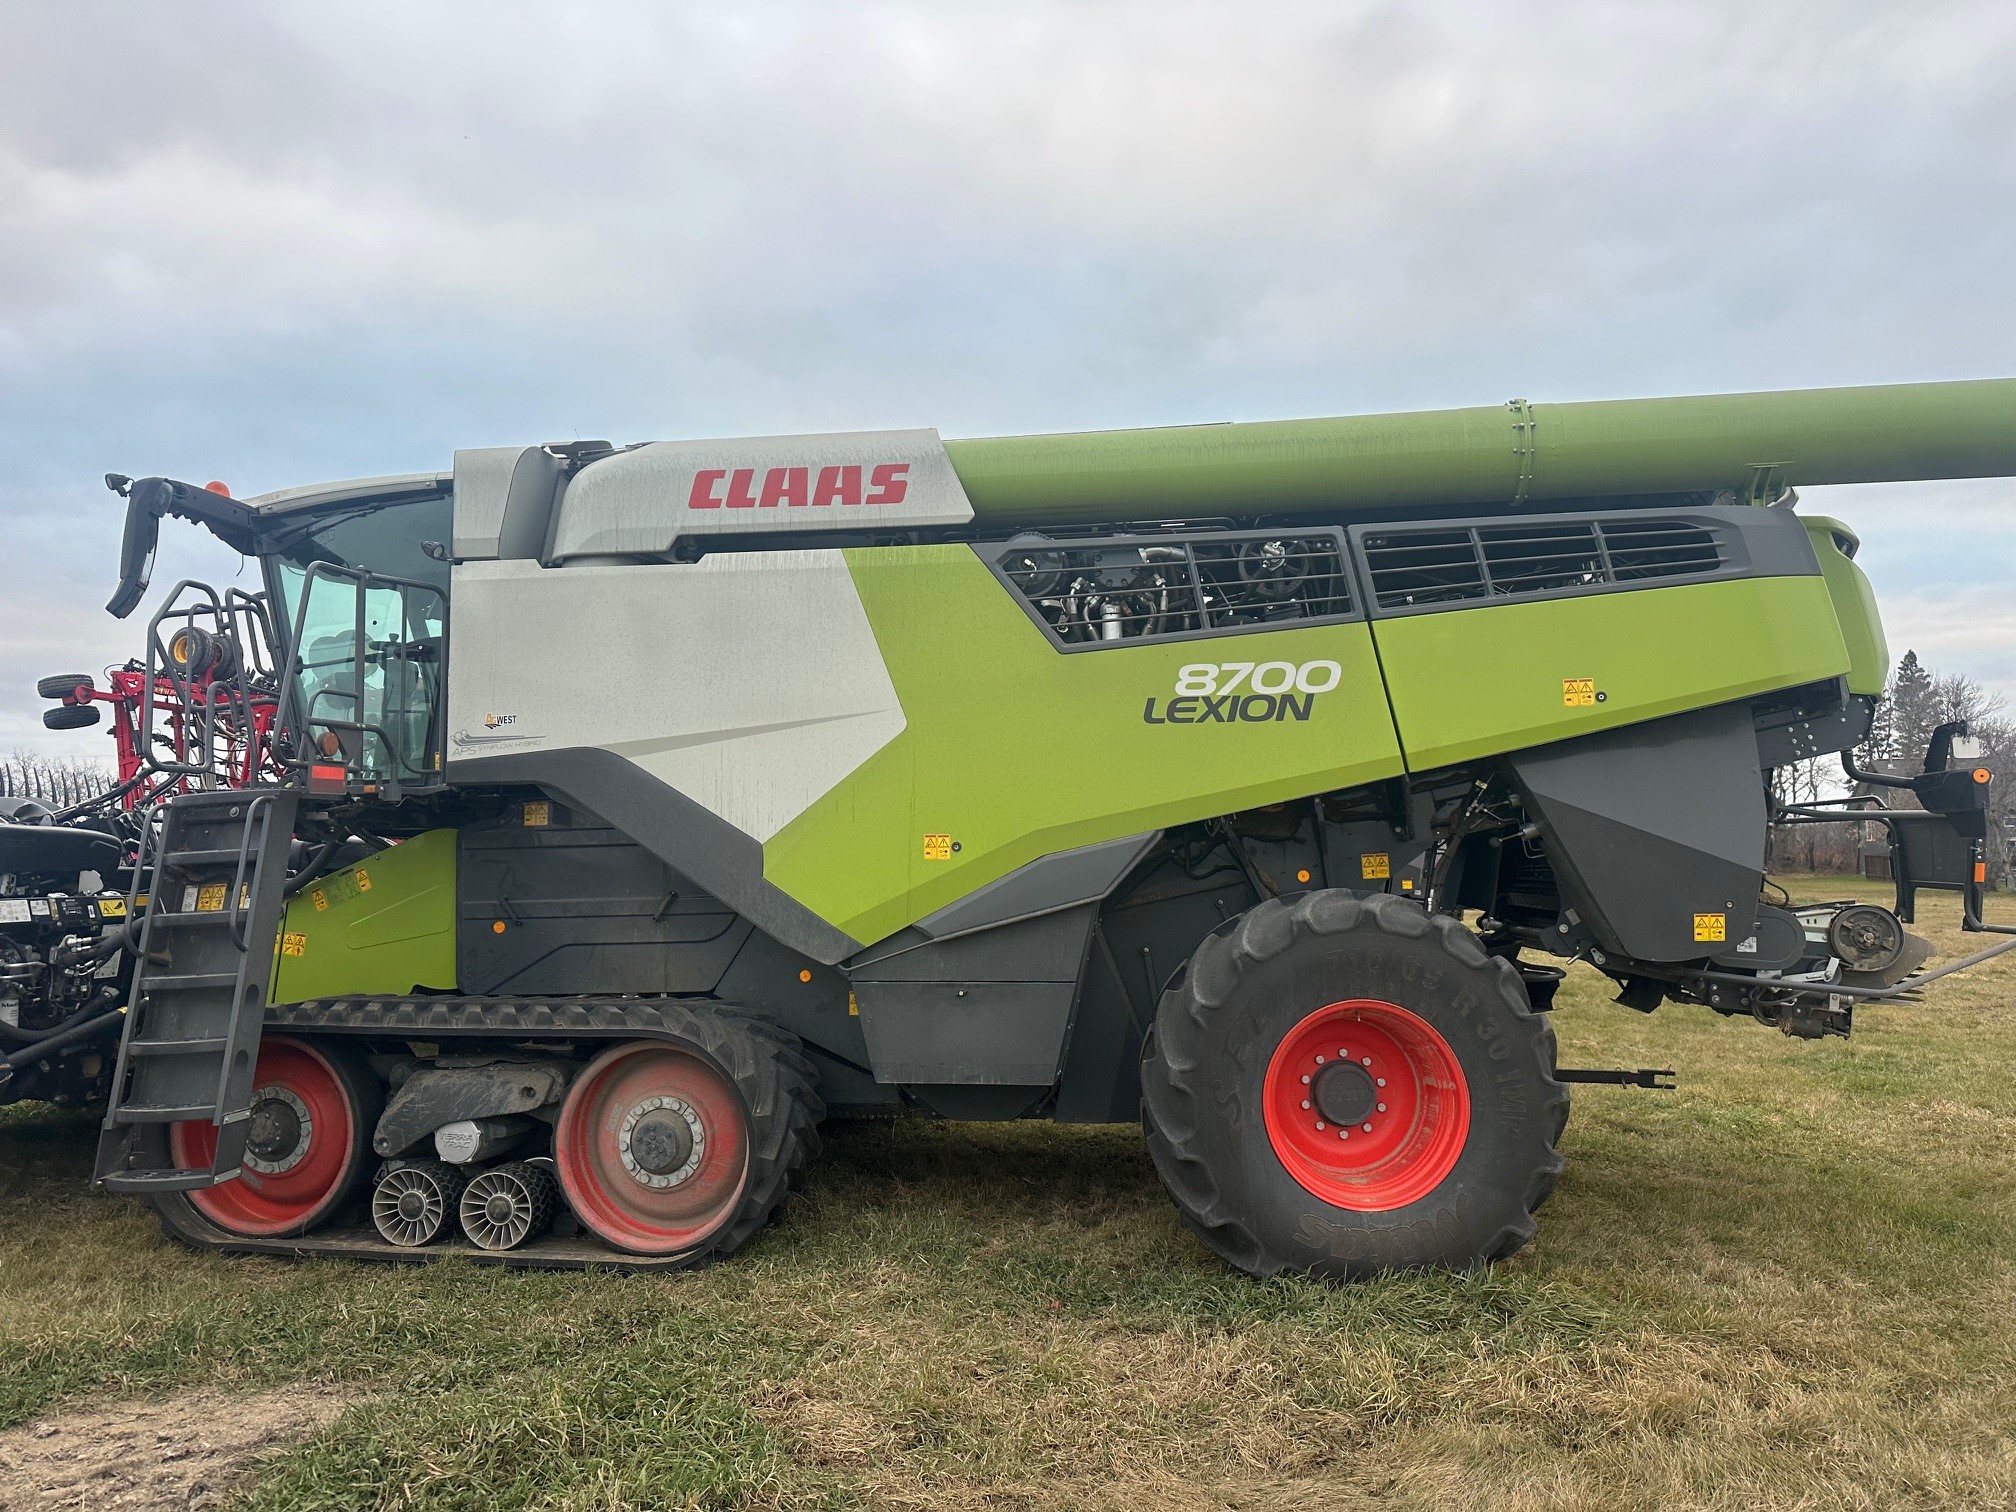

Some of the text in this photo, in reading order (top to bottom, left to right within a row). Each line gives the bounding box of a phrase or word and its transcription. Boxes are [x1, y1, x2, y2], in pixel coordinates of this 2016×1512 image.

[688, 463, 910, 509] CLAAS
[1174, 659, 1342, 697] 8700
[1143, 693, 1315, 724] LEXION
[452, 746, 476, 757] APS
[515, 739, 541, 748] HYBRID
[440, 1133, 473, 1141] TERRA
